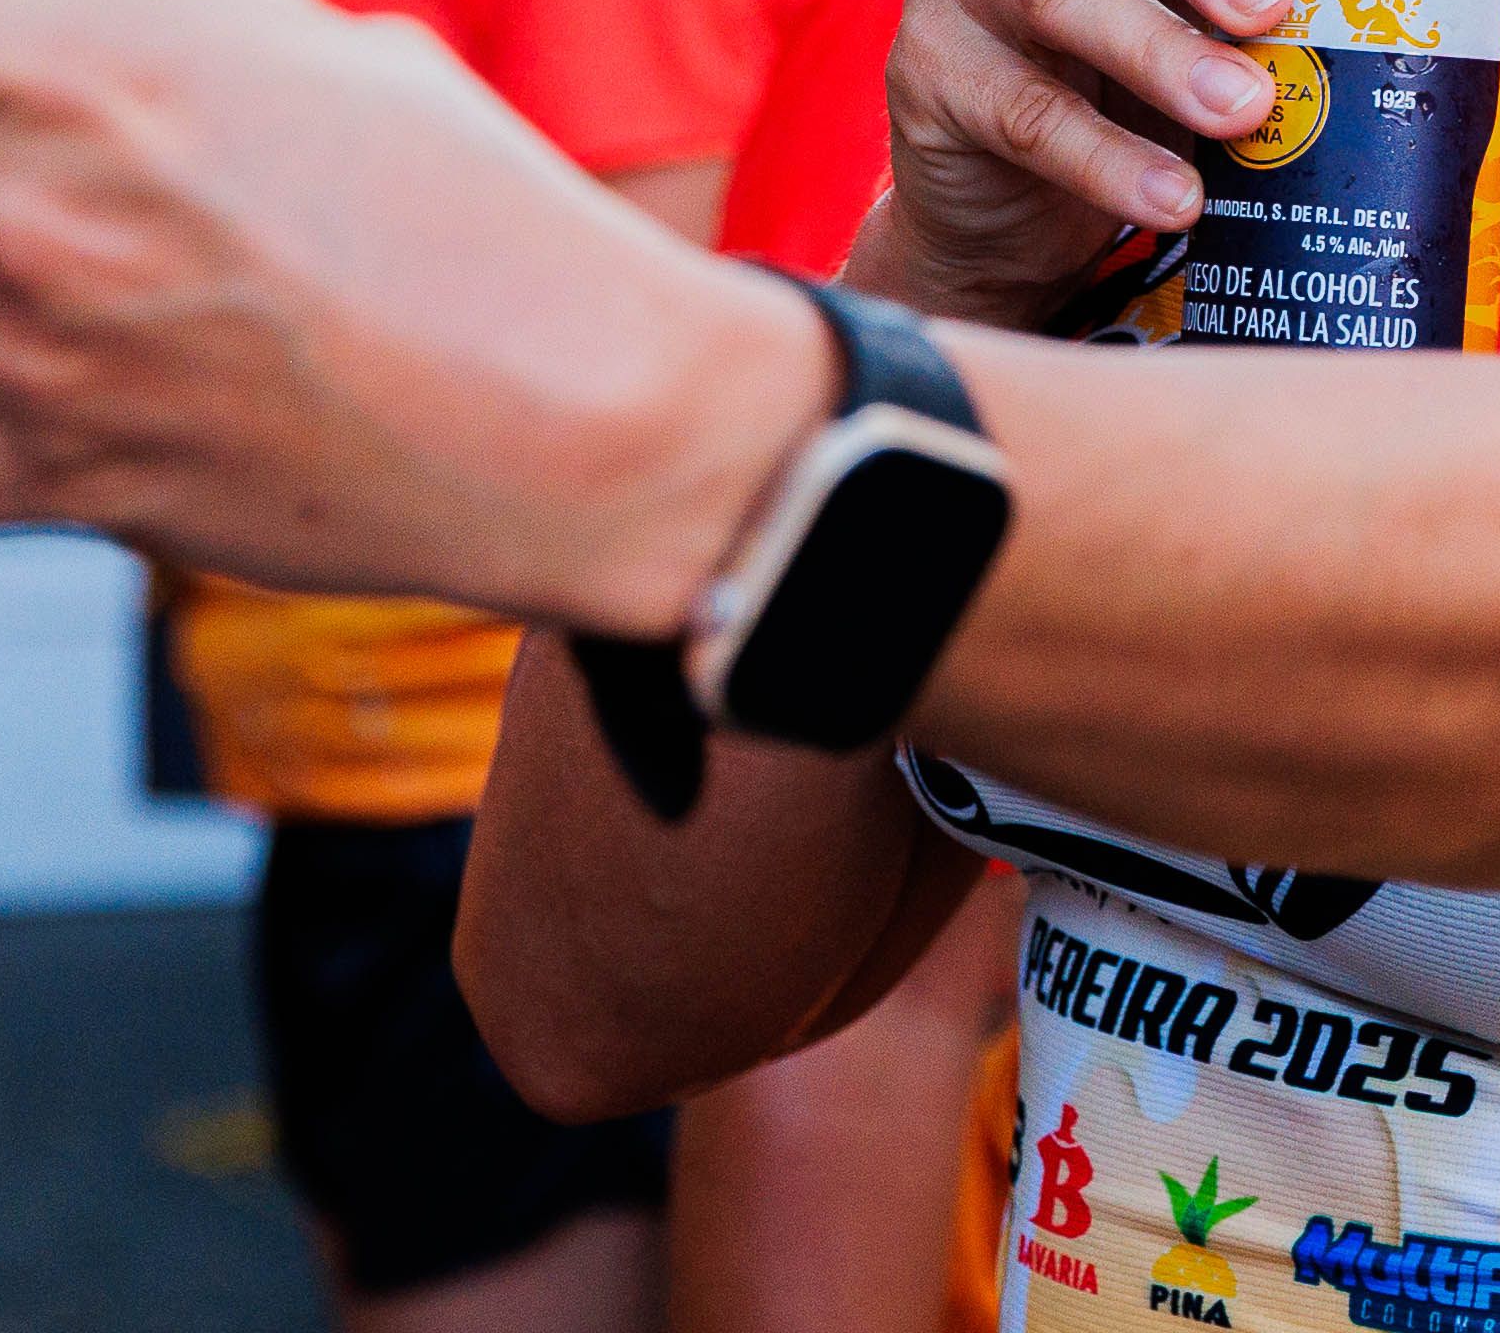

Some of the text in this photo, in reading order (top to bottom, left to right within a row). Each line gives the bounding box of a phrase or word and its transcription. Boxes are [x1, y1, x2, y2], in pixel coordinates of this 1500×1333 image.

[1372, 88, 1416, 110] 1925
[1214, 199, 1268, 222] MODELO,
[1271, 203, 1286, 221] S.
[1291, 204, 1312, 223] DE
[1315, 206, 1348, 226] R.L.
[1354, 209, 1376, 227] DE
[1380, 210, 1411, 230] C.V.
[1301, 234, 1409, 259] 4.5 % Alc./Vol.
[1225, 265, 1254, 297] DE
[1258, 268, 1383, 308] ALCOHOL
[1390, 277, 1420, 310] ES
[1233, 305, 1291, 341] PARA
[1298, 311, 1329, 344] LA
[1335, 313, 1418, 349] SALUD
[1024, 915, 1493, 1118] PEREIRA 2025
[1150, 1283, 1232, 1329] PINA
